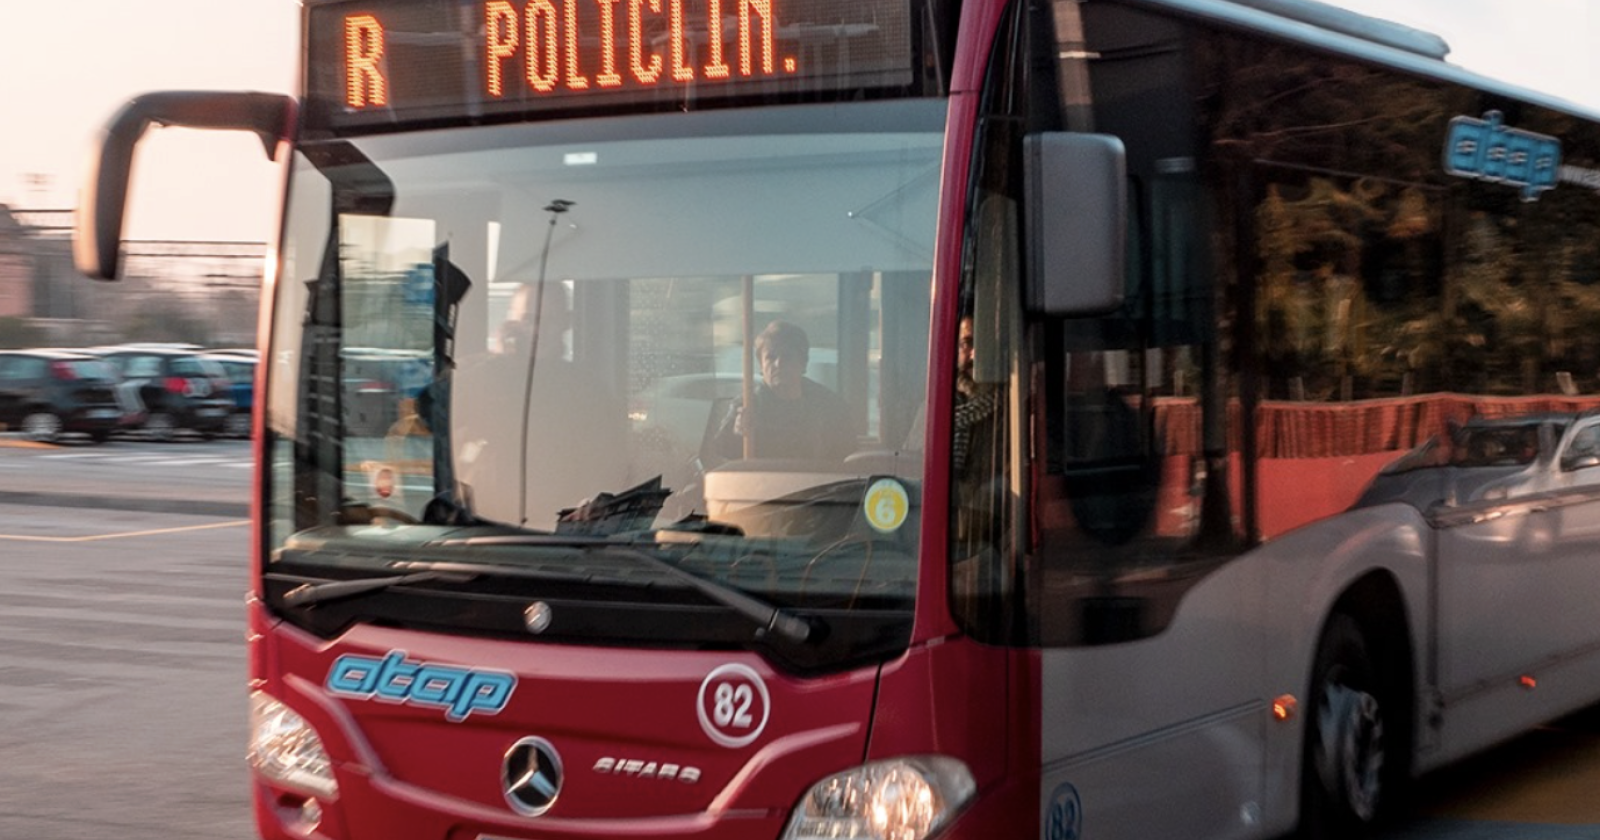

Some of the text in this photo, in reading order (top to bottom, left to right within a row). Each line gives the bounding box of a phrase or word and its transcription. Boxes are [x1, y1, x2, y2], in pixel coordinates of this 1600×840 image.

[345, 0, 797, 107] R POLICLIN.
[875, 497, 896, 524] 6
[326, 649, 518, 722] atap
[713, 682, 753, 728] 82
[1051, 799, 1078, 840] 82
